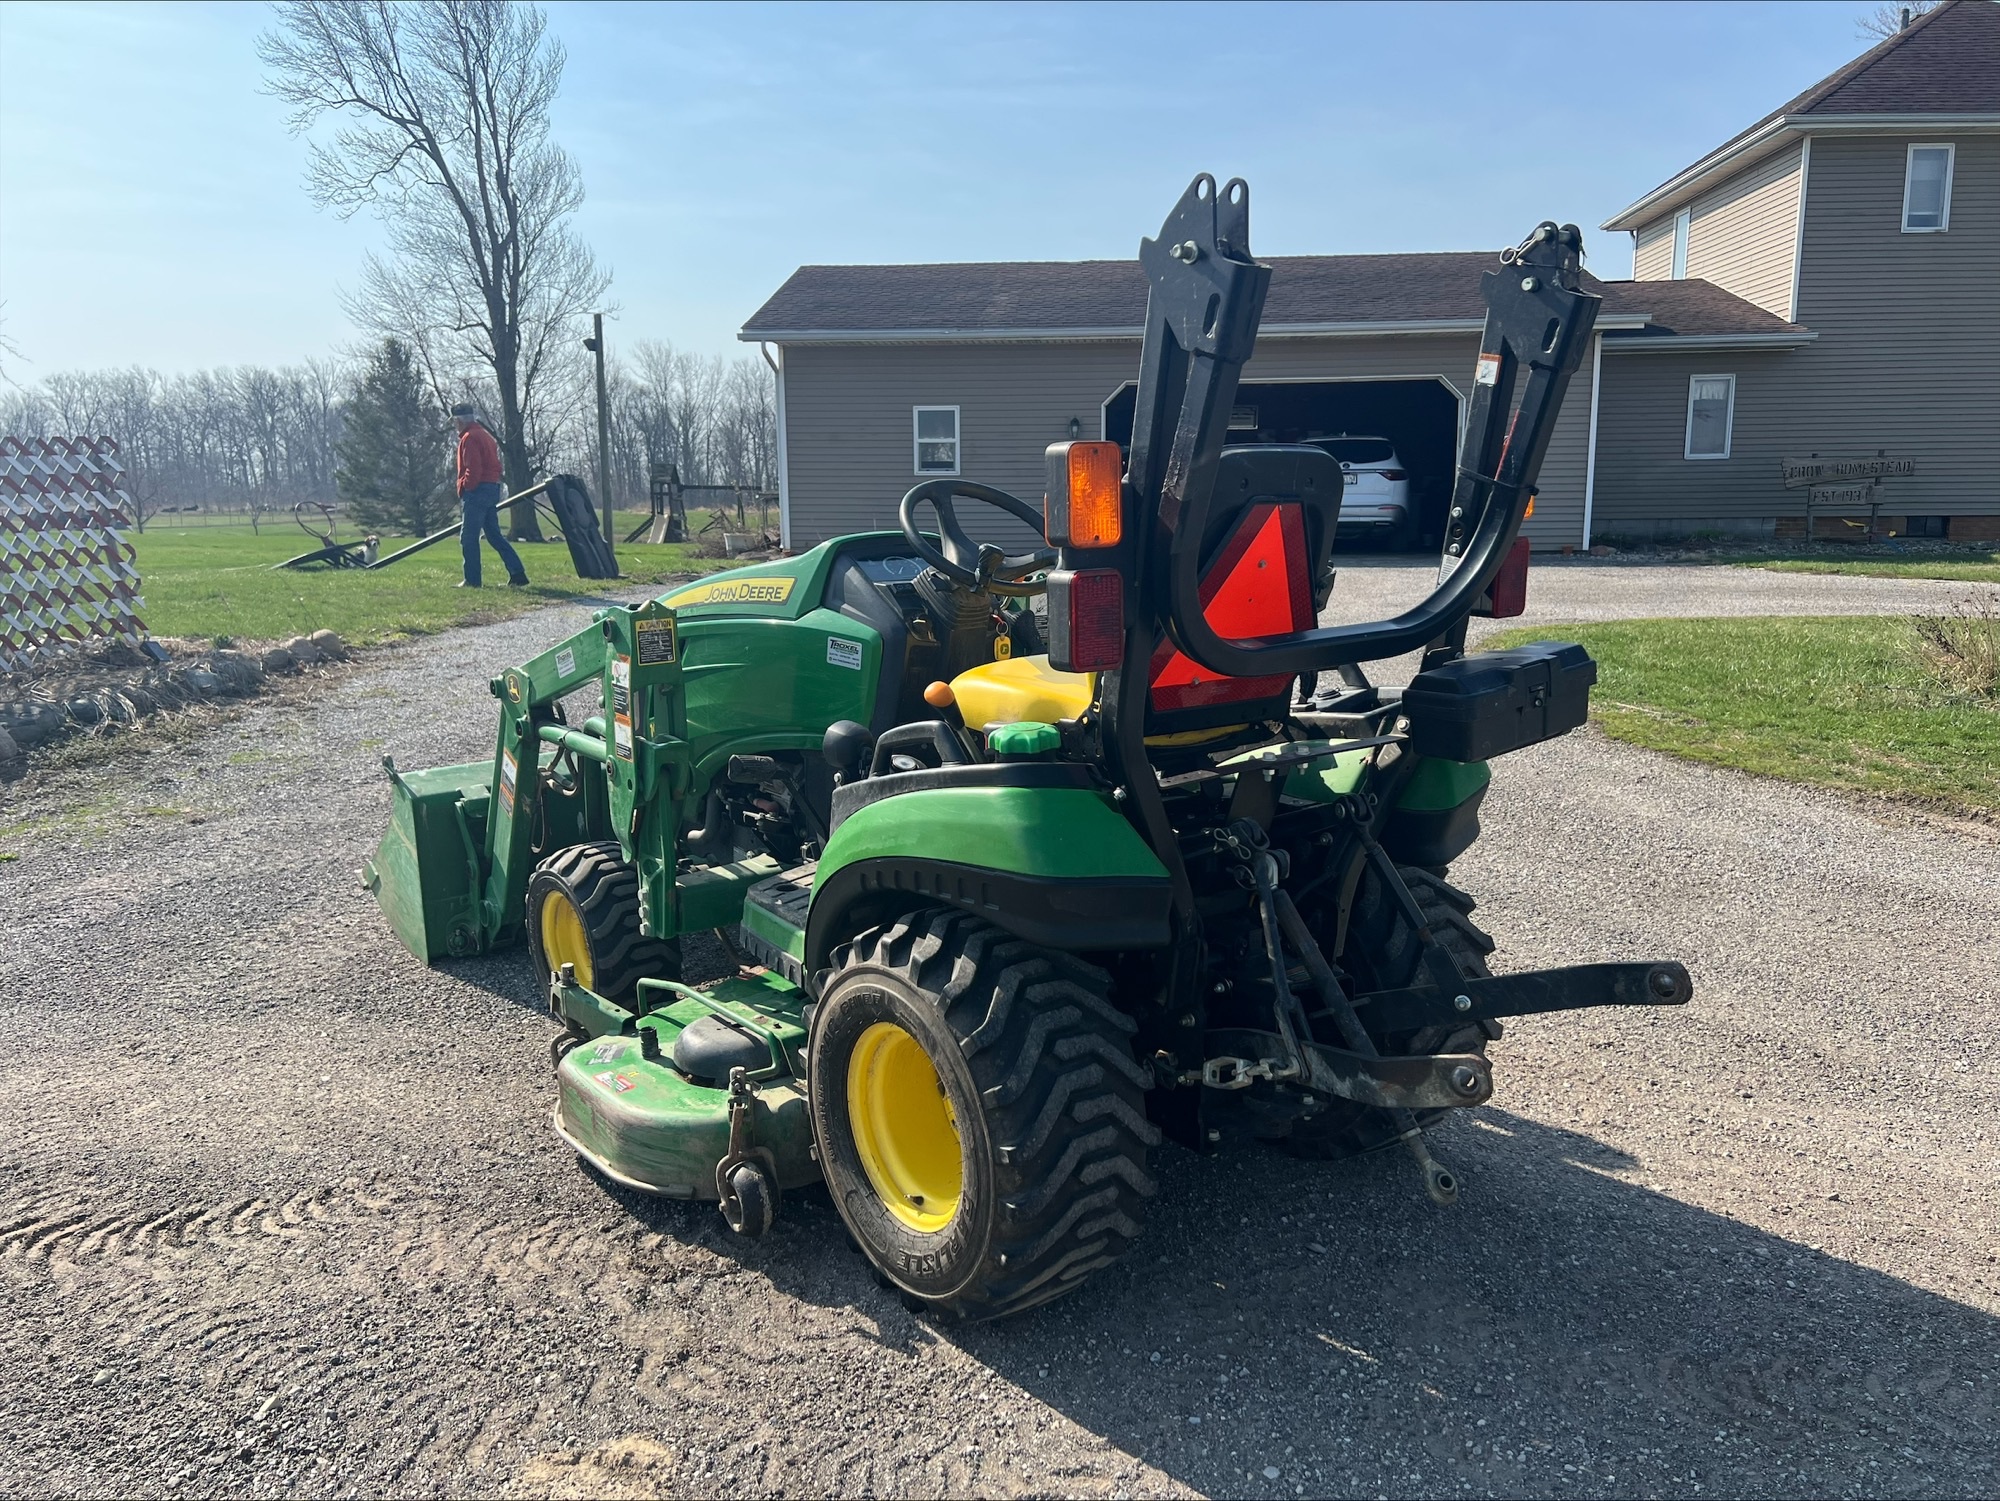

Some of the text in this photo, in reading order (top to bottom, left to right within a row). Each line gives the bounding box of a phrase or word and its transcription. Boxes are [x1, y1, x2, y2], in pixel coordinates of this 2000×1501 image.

[1836, 460, 1911, 476] HOMESTEAD
[704, 583, 784, 602] JOHN DEERE
[840, 991, 882, 1016] CHIEF
[897, 1189, 974, 1275] CARLISLE
